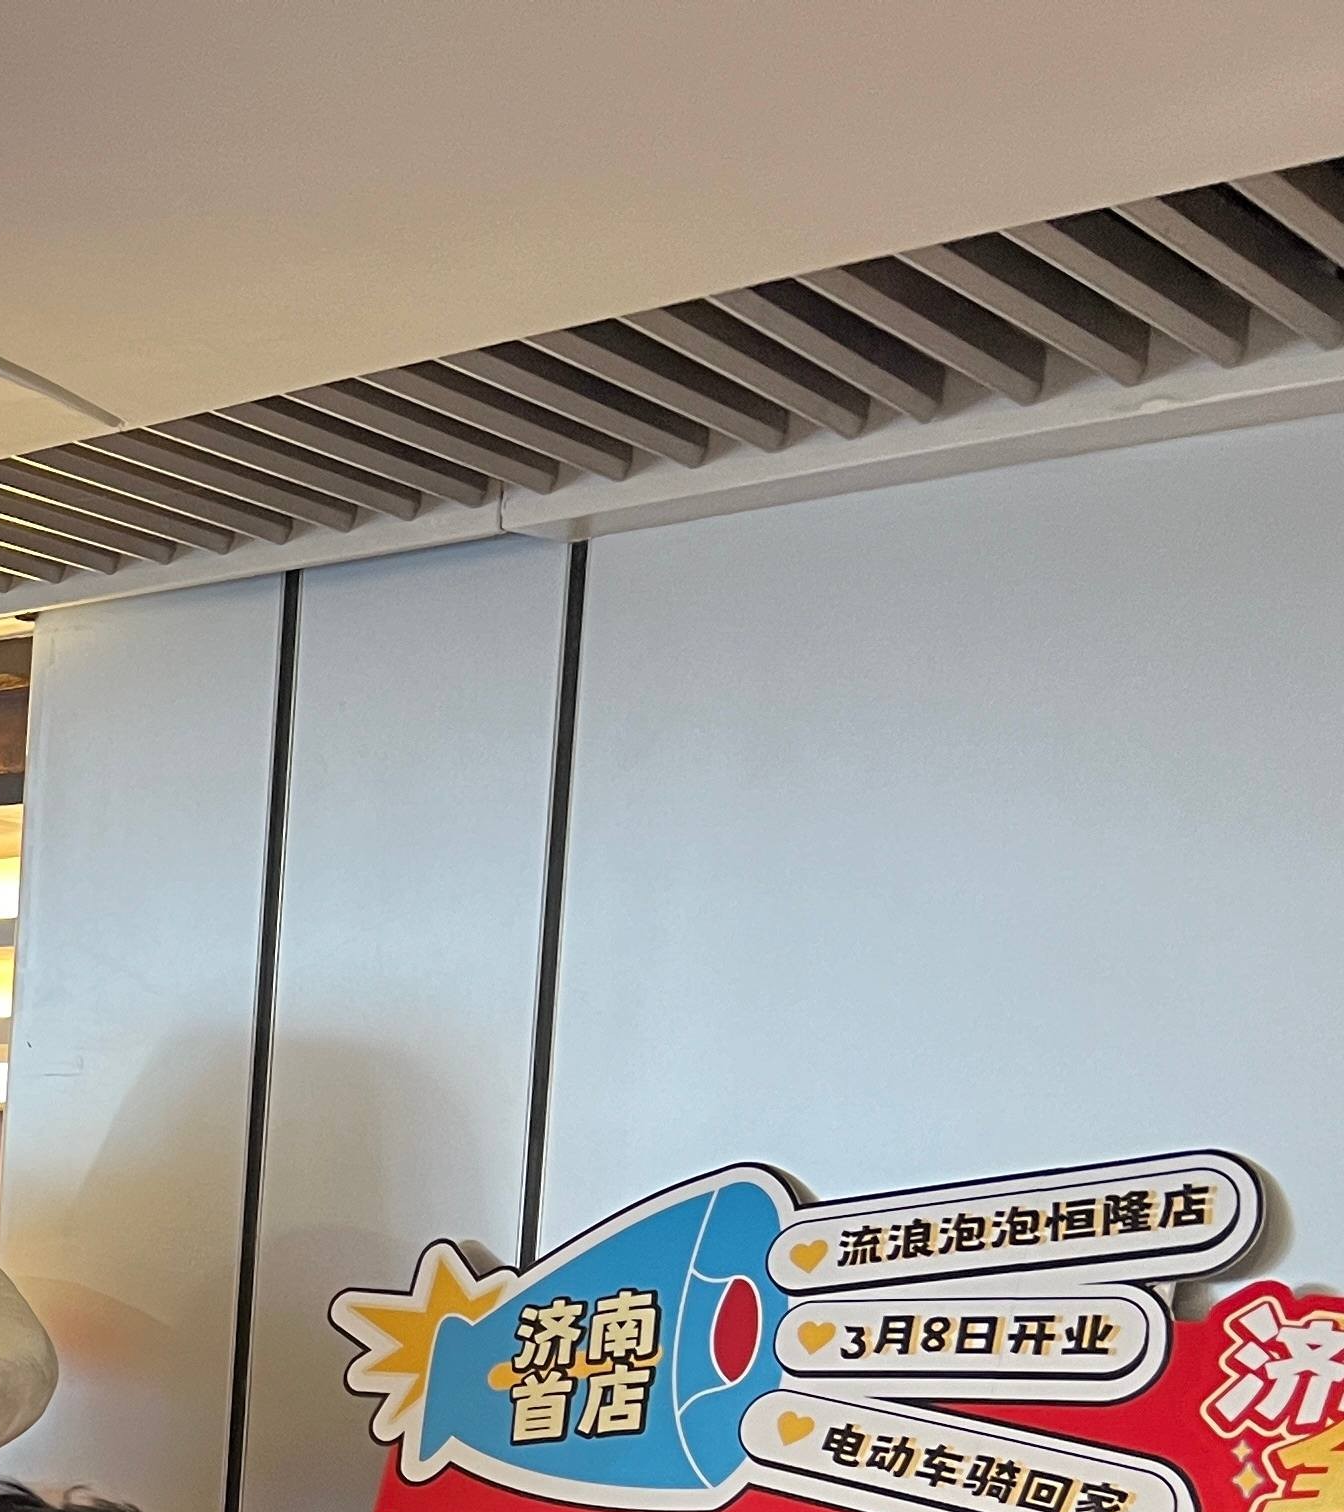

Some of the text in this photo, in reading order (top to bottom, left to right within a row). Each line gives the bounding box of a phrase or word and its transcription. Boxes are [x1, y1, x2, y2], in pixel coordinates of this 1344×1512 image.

[836, 1183, 1213, 1268] 流浪泡泡恒隆店
[512, 1289, 659, 1371] 济南
[839, 1314, 1115, 1360] 3月8日开业
[511, 1364, 652, 1443] 首店
